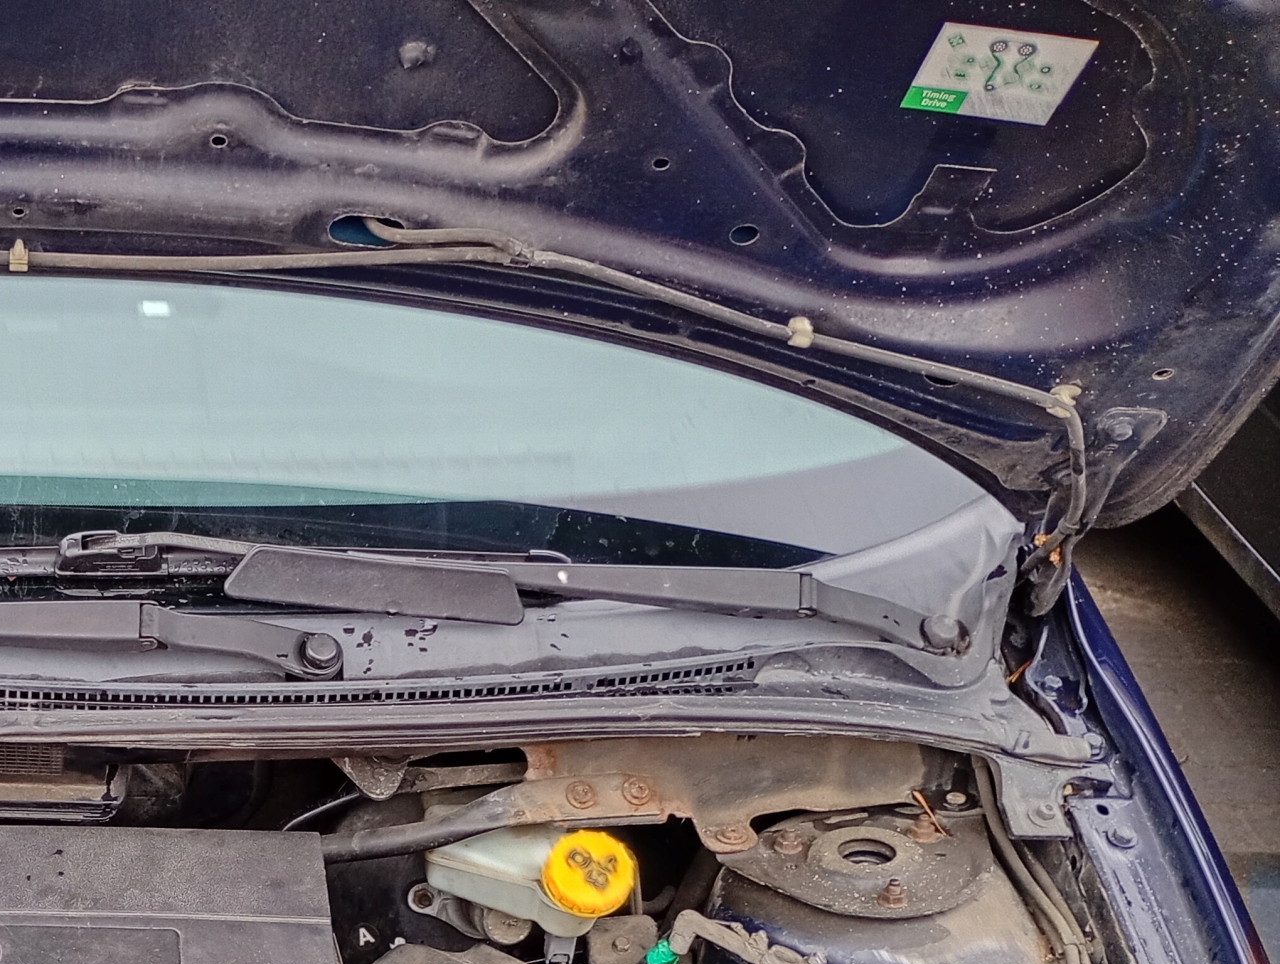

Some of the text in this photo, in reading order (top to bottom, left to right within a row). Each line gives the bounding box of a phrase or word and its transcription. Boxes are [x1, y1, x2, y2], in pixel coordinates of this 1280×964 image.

[922, 90, 957, 102] Timing
[921, 98, 947, 108] Drive
[359, 927, 376, 946] A
